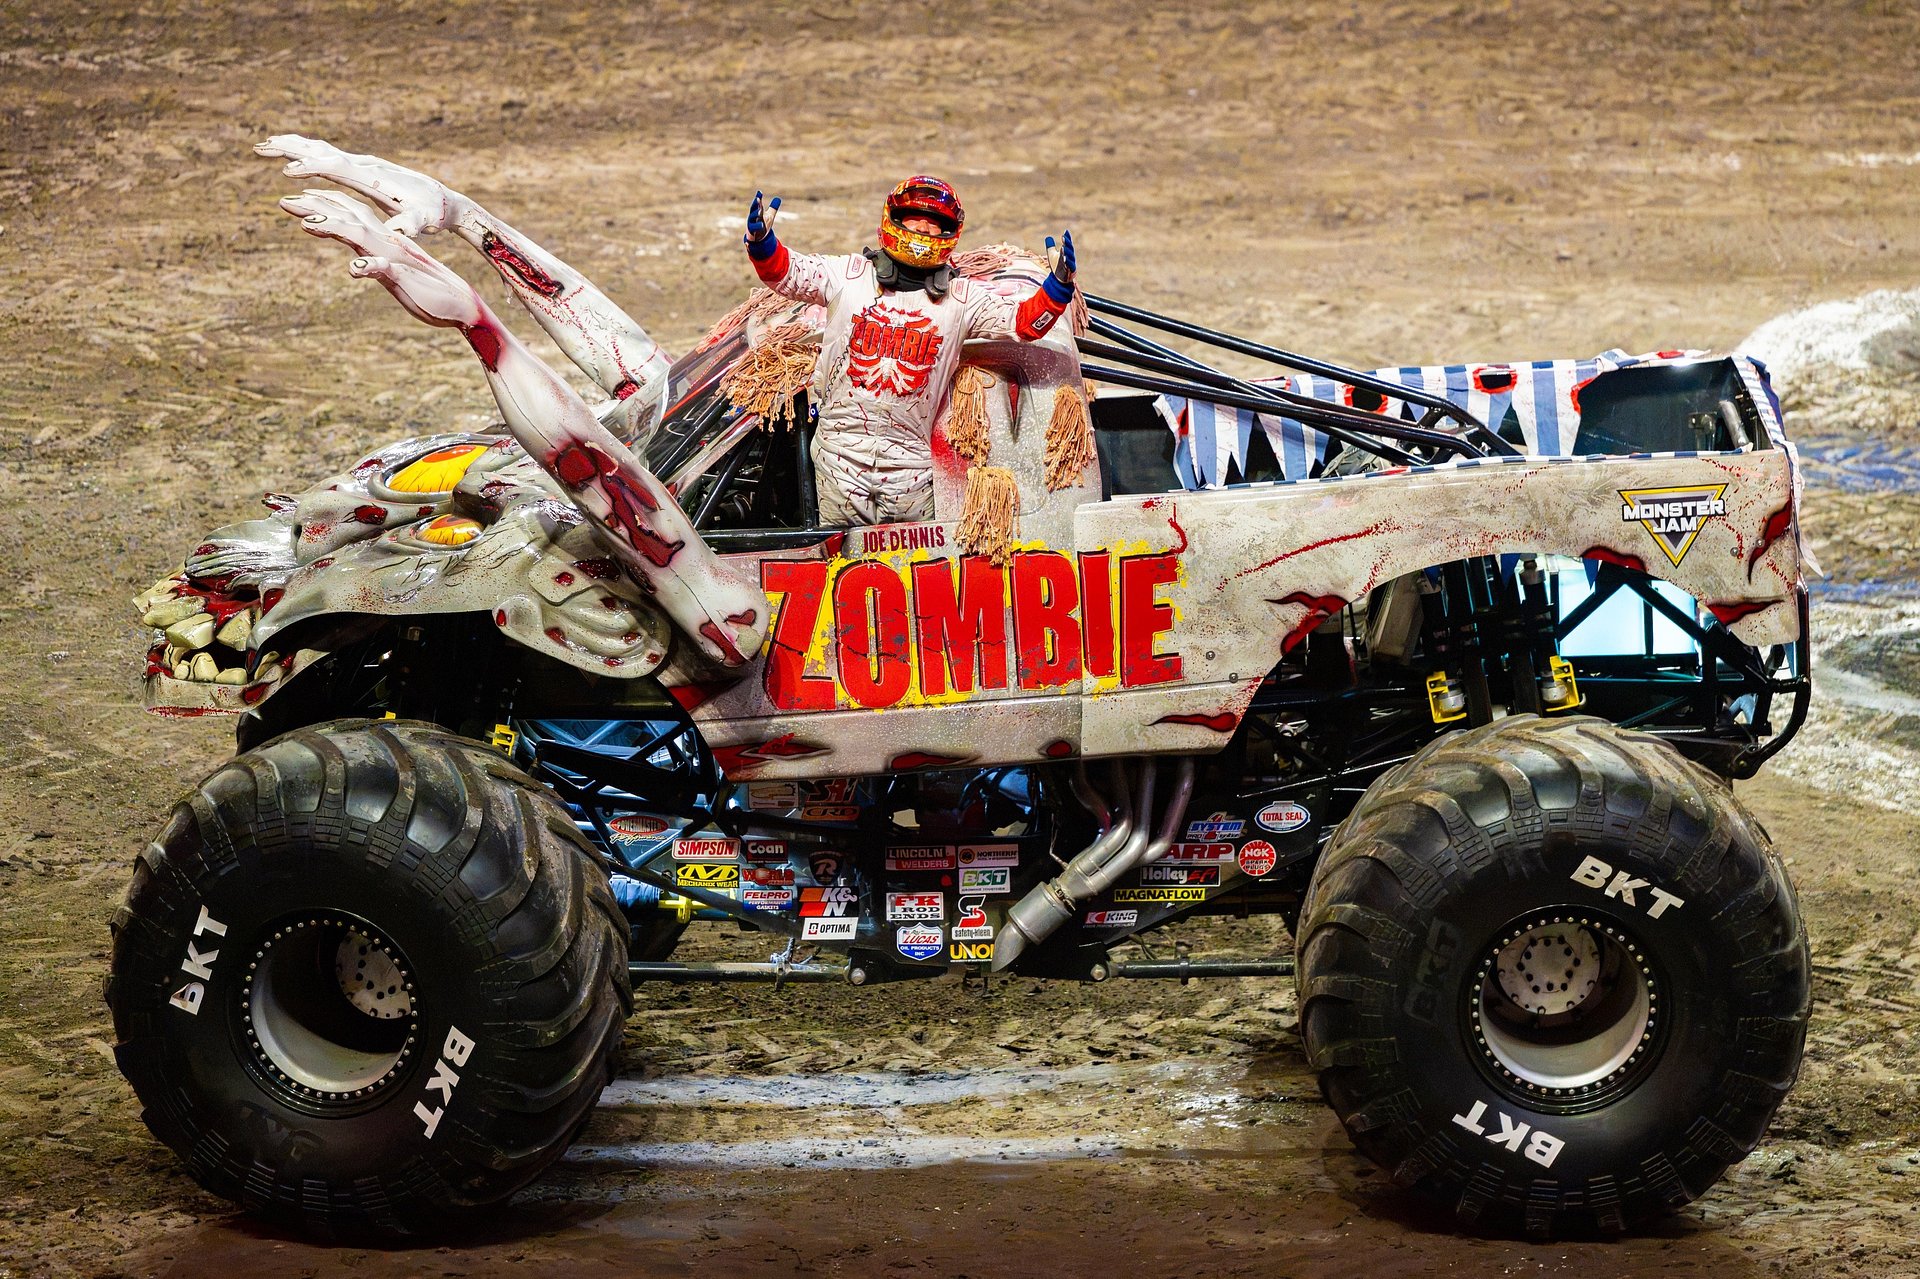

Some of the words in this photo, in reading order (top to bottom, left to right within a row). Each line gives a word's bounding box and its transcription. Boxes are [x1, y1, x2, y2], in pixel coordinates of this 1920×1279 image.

[850, 314, 943, 365] ZOMBIE
[1622, 499, 1725, 520] MONSTER
[1653, 517, 1698, 533] JAM
[863, 531, 887, 553] JOE
[890, 525, 945, 551] DENNIS
[759, 548, 1185, 710] ZOMBIE
[1262, 812, 1284, 822] TOTAL
[1285, 811, 1304, 821] SEAL
[678, 841, 737, 856] SIMPSON
[748, 842, 785, 854] Coan
[889, 848, 944, 859] LINCOLN
[1160, 844, 1233, 859] ARP
[1244, 848, 1270, 858] NGK
[901, 859, 950, 869] WELDERS
[963, 871, 1007, 885] BKT
[1143, 867, 1188, 884] Holley
[677, 878, 715, 888] MECHANIX
[716, 880, 739, 888] WEAR
[1570, 855, 1685, 919] BKT
[896, 895, 940, 906] FK
[1115, 889, 1204, 901] MAGNAFLOW
[1106, 911, 1137, 921] KING
[820, 924, 850, 934] OPTIMA
[954, 929, 992, 939] safety-kleen
[903, 935, 940, 944] LUCAS
[169, 904, 228, 1016] BKT
[413, 1025, 476, 1140] BKT
[1452, 1100, 1566, 1169] BKT
